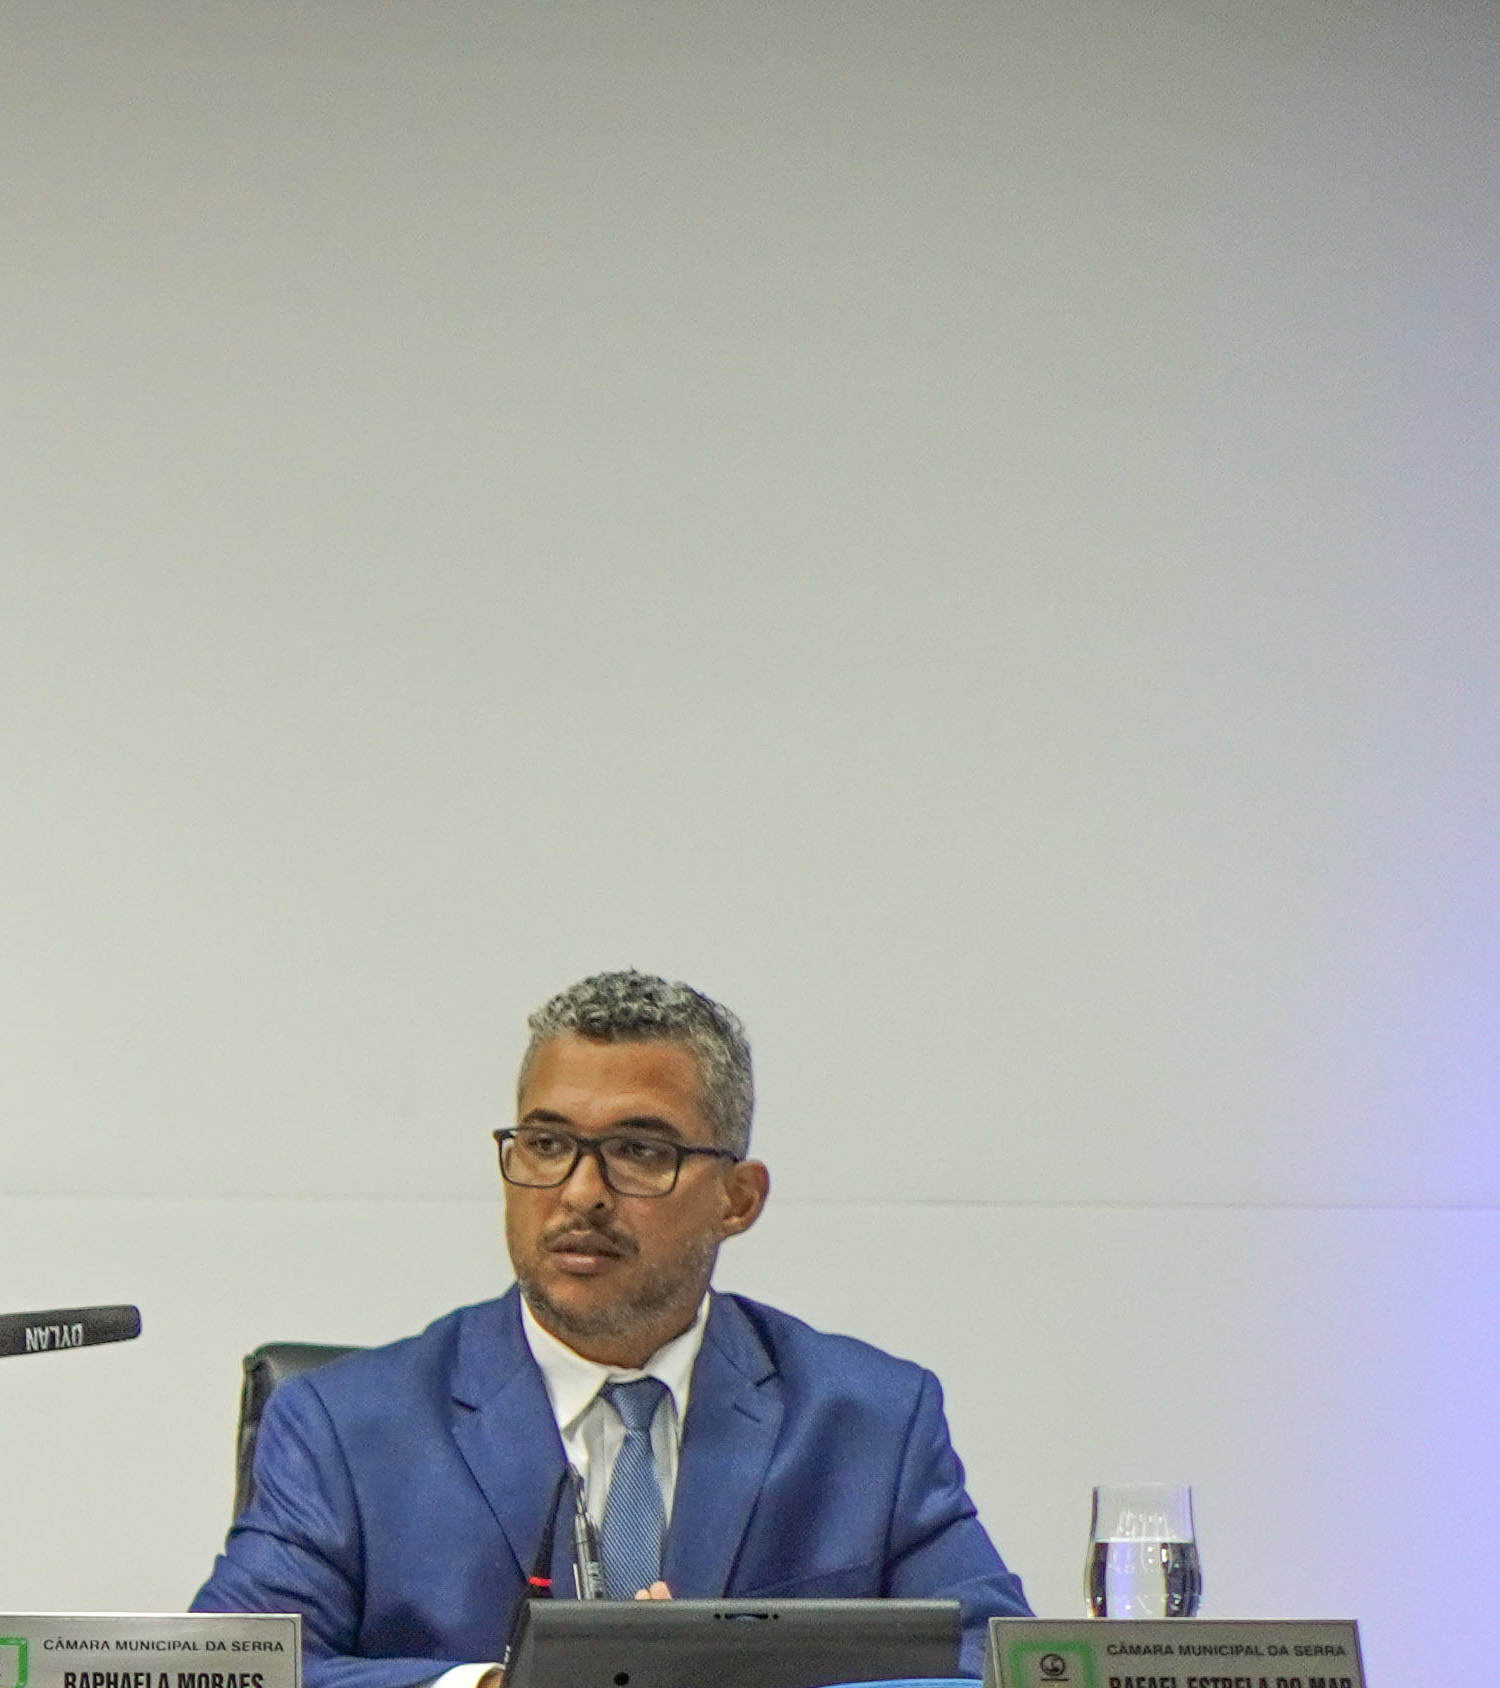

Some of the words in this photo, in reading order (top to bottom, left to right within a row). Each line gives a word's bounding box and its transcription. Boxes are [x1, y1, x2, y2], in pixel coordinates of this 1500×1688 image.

[25, 1323, 84, 1351] DYLAN
[43, 1636, 110, 1651] CÂMARA
[115, 1639, 200, 1652] MUNICIPAL
[205, 1640, 226, 1652] DA
[231, 1640, 284, 1653] SERRA
[1179, 1645, 1263, 1657] MUNICIPAL
[1268, 1645, 1289, 1657] DA
[1294, 1645, 1345, 1657] SERRA
